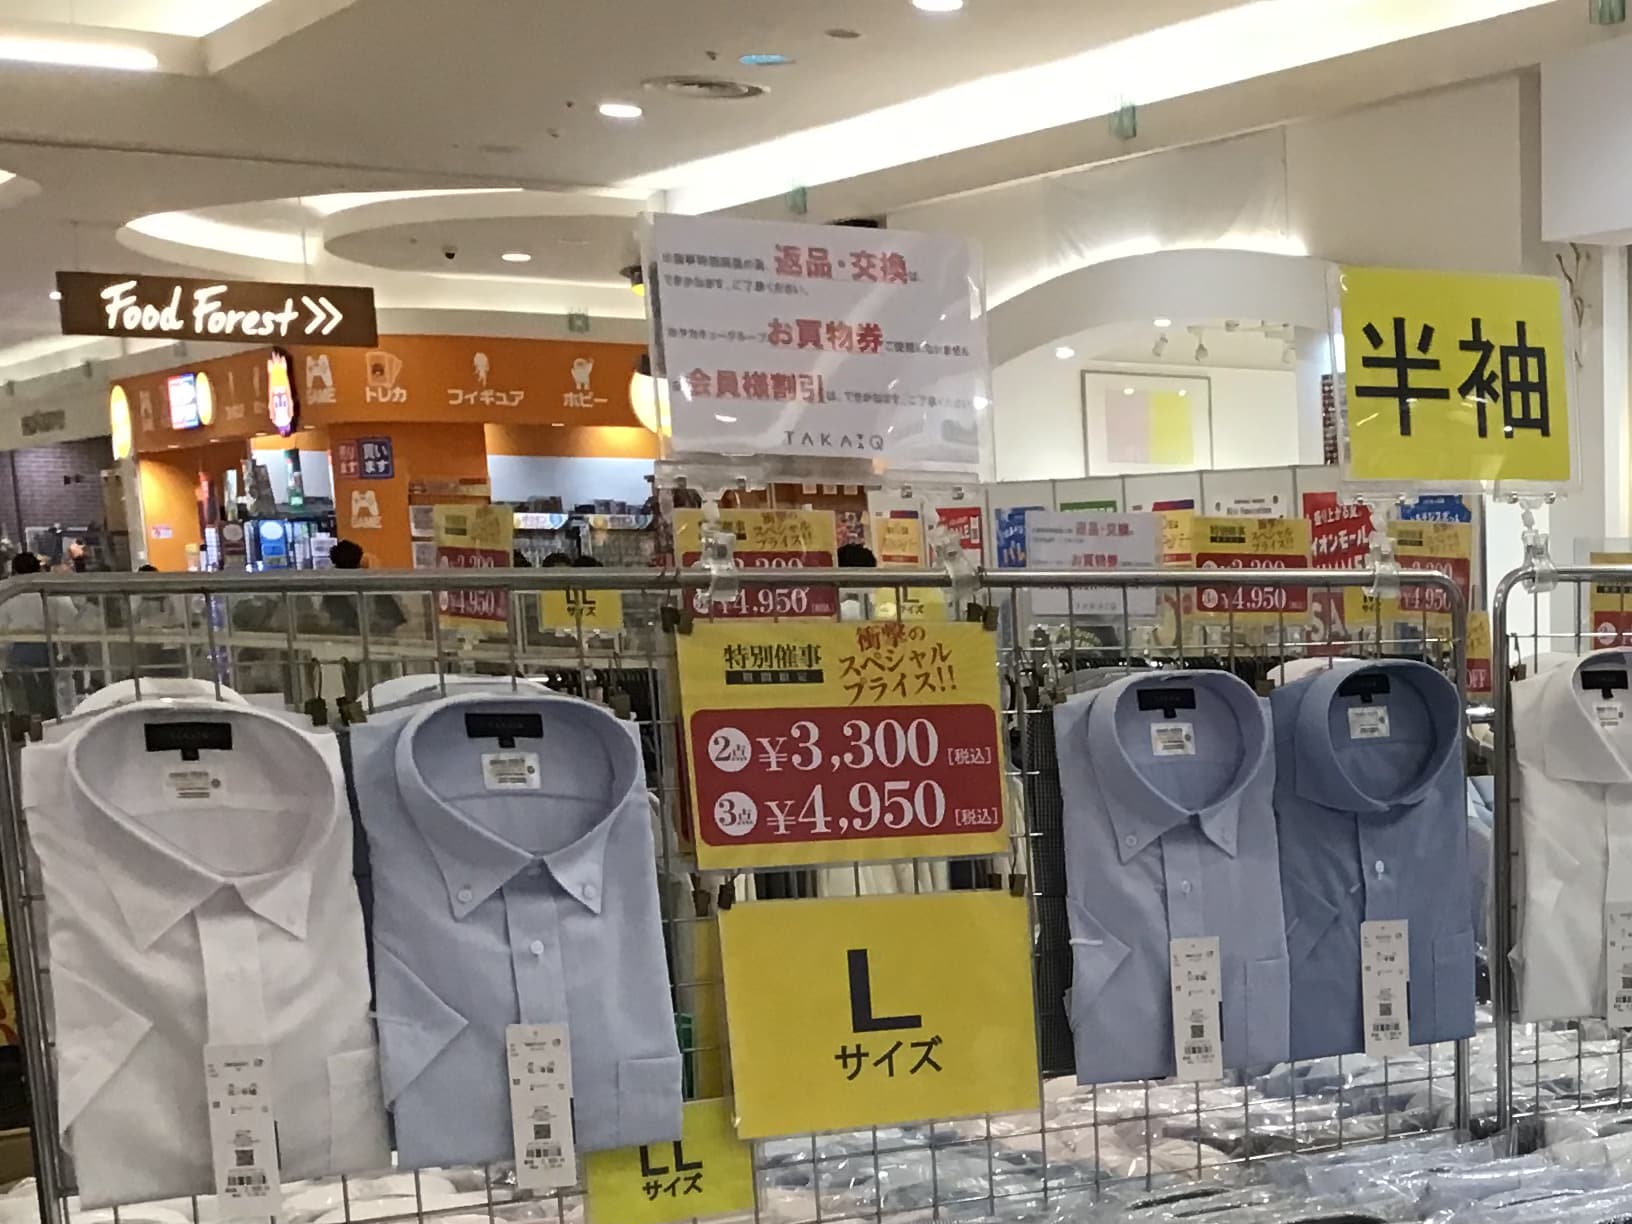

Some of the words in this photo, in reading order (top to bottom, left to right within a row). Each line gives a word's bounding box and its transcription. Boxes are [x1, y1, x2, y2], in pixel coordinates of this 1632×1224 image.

[100, 280, 184, 330] Food
[193, 285, 299, 337] Forest
[767, 318, 884, 354] お買物券
[687, 367, 825, 405] 会員様割引
[1355, 317, 1551, 438] 半袖
[856, 621, 926, 652] 衝撃の
[724, 643, 823, 670] 特別催事
[838, 641, 953, 680] スペシャル
[755, 718, 939, 773] ¥3,300
[764, 779, 946, 836] ¥4,950
[847, 948, 922, 1033] L
[834, 1034, 943, 1081] サイズ
[639, 1140, 703, 1177] LL
[642, 1173, 703, 1201] サイズ
